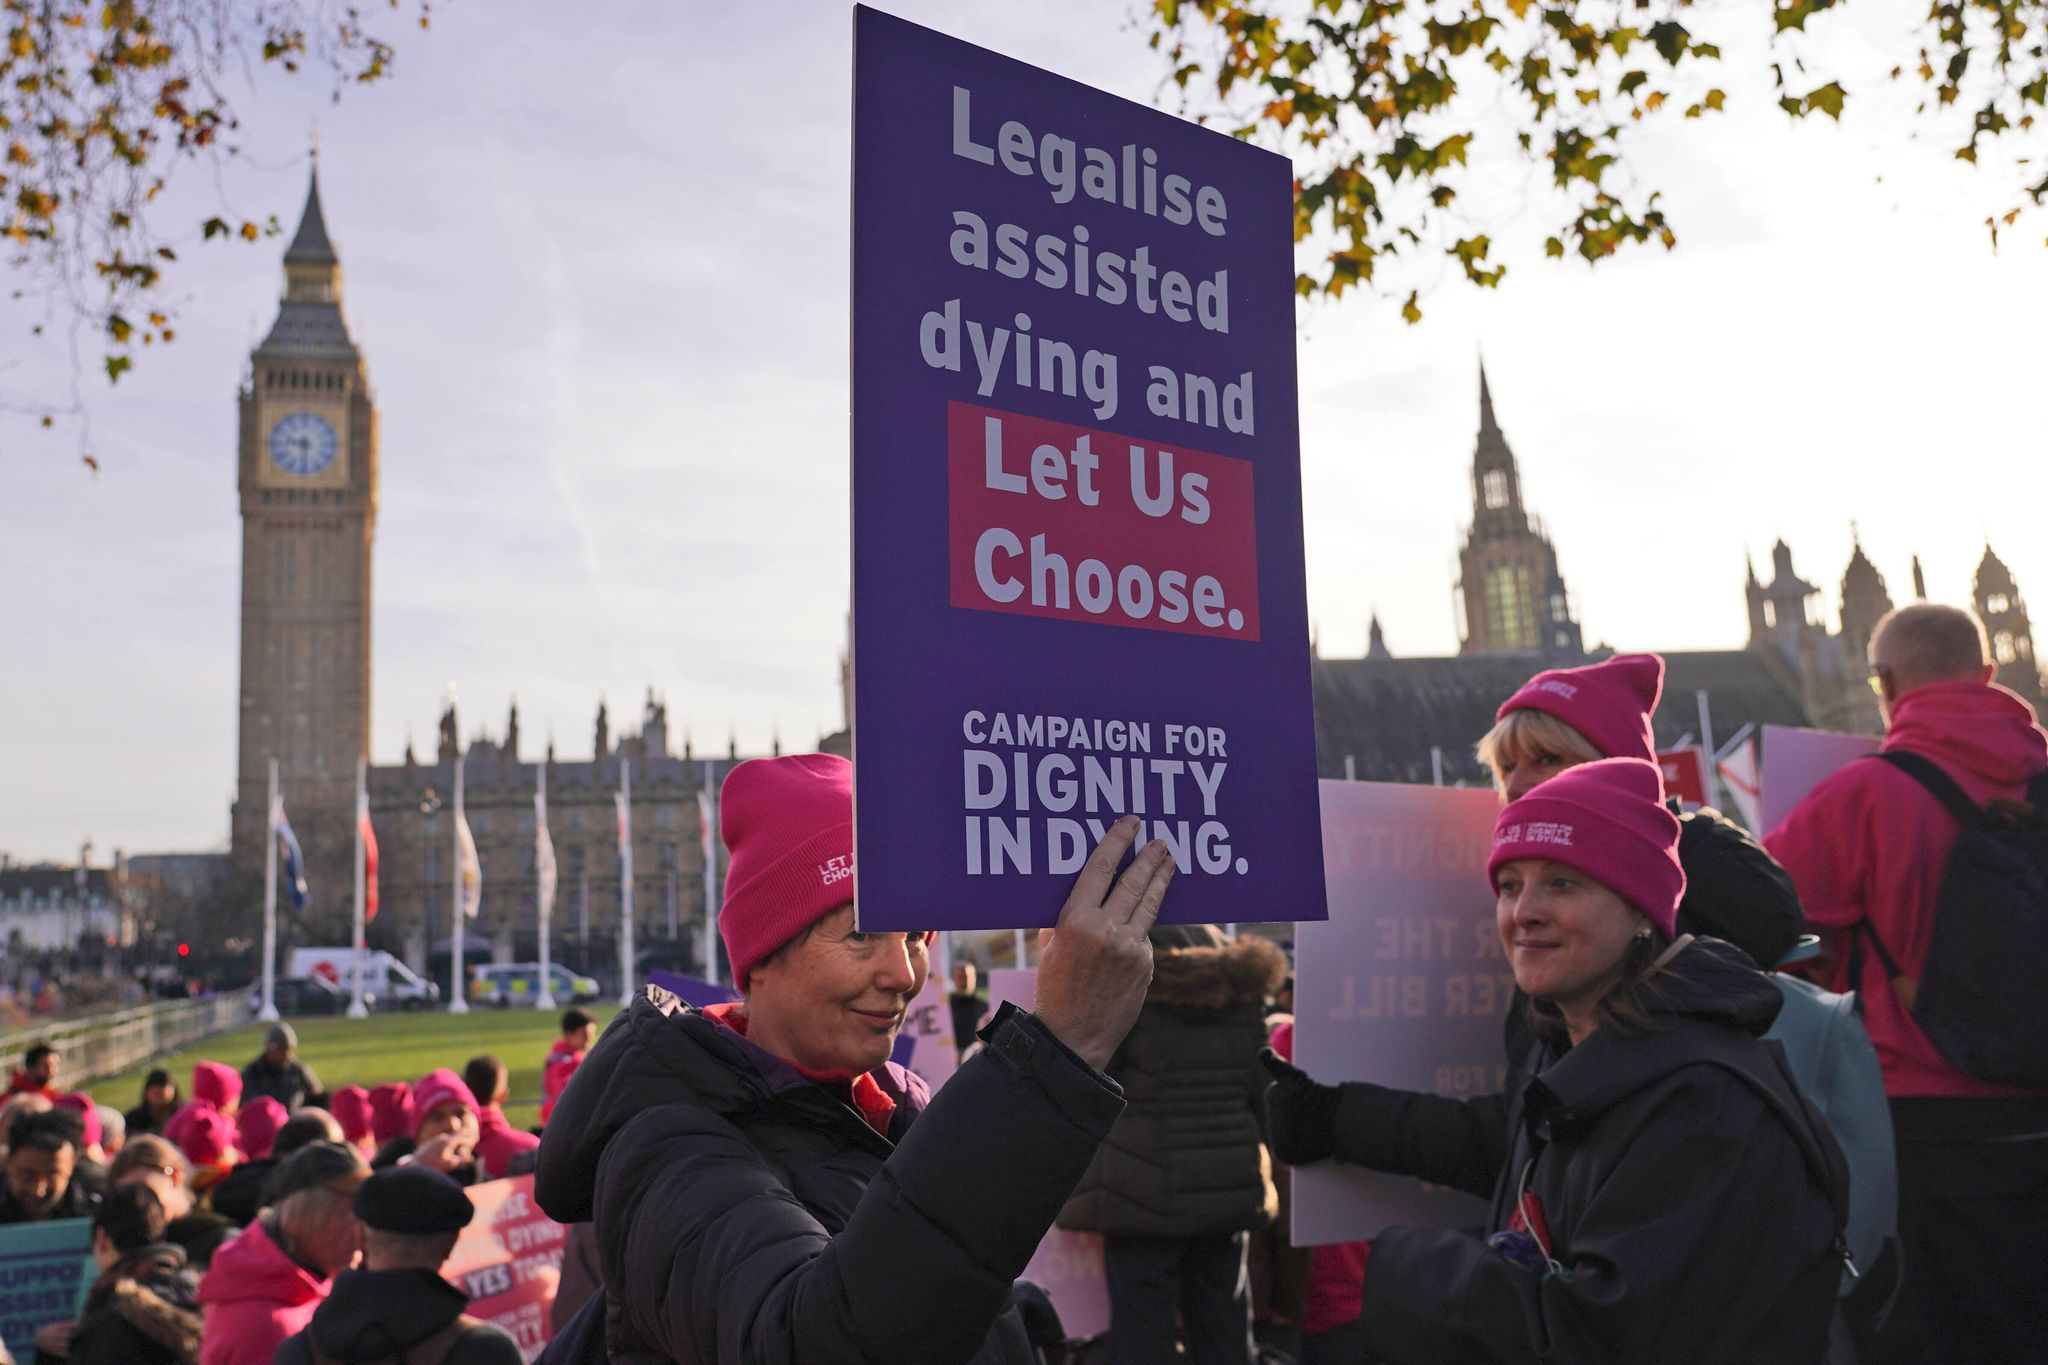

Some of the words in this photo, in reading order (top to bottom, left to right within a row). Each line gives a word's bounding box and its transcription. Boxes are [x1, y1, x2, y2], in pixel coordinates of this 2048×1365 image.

[953, 85, 1228, 237] Legalise
[950, 210, 1229, 334] assisted
[919, 298, 1118, 421] dying
[1146, 371, 1255, 437] and
[985, 415, 1100, 507] Let
[1129, 444, 1211, 525] Us
[974, 527, 1244, 631] Choose.
[962, 710, 1151, 753] CAMPAIGN
[1164, 723, 1228, 758] FOR
[963, 749, 1228, 816] DIGNITY
[818, 855, 846, 876] LET
[965, 815, 1032, 875] IN
[466, 1264, 511, 1300] YES
